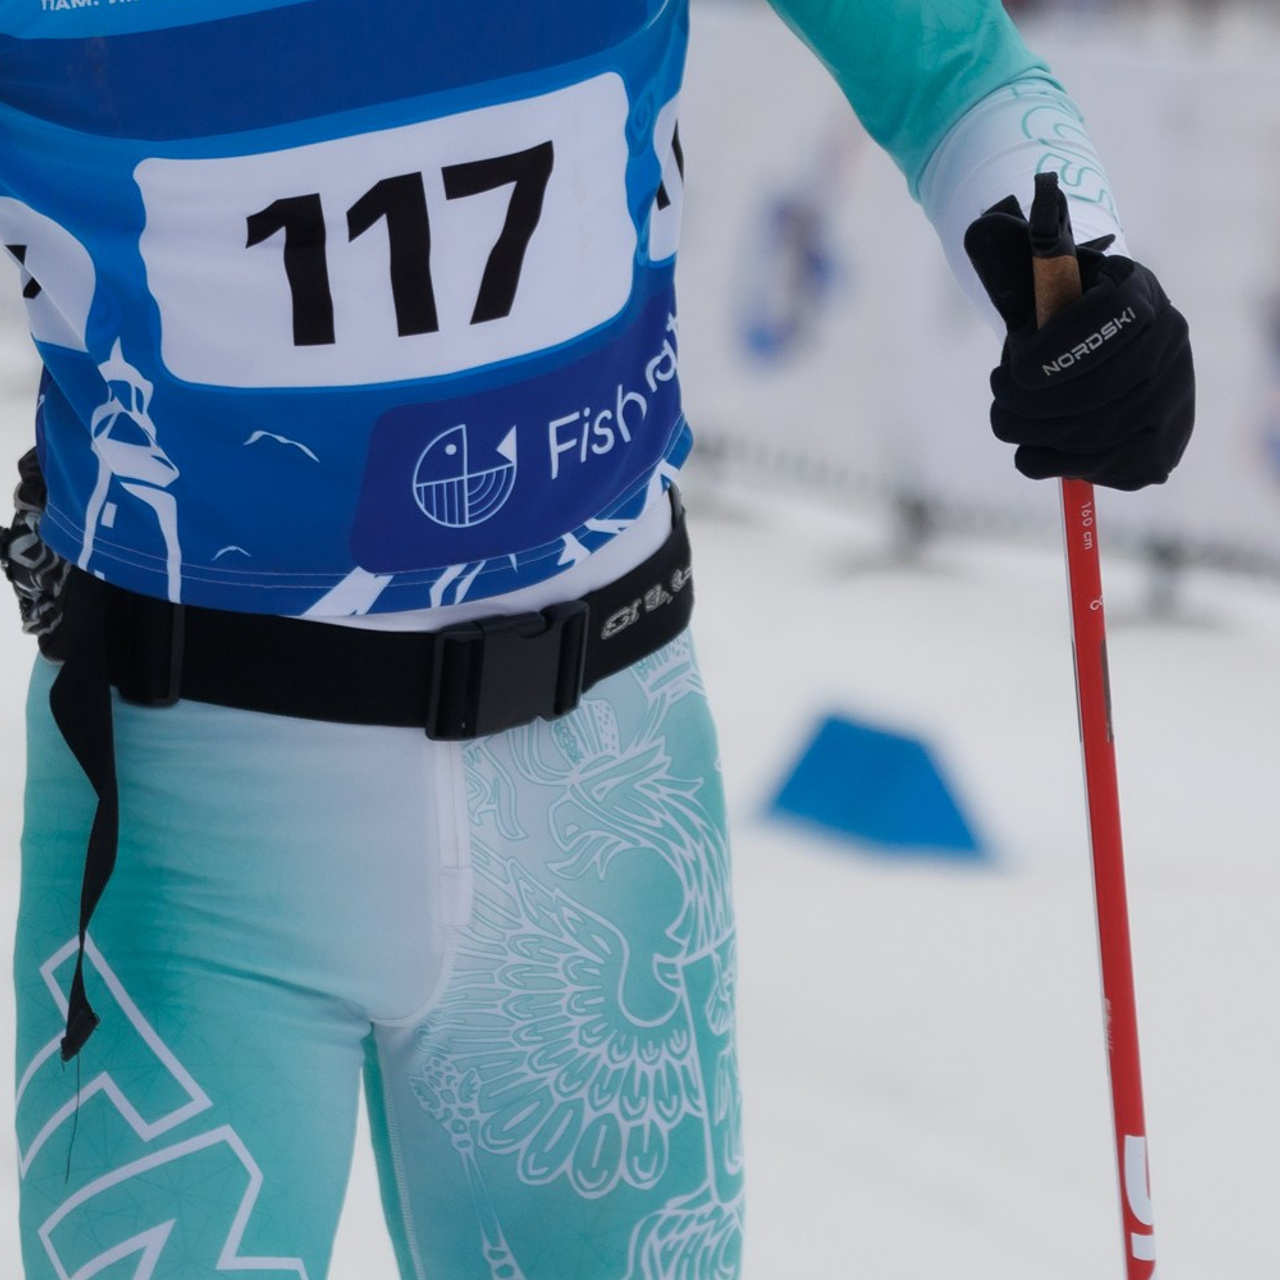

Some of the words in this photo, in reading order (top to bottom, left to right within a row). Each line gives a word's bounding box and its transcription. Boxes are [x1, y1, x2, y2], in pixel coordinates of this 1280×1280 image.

[245, 140, 555, 347] 117
[1042, 307, 1136, 376] NORDSKI
[1081, 501, 1093, 527] 160
[1083, 531, 1094, 550] cm
